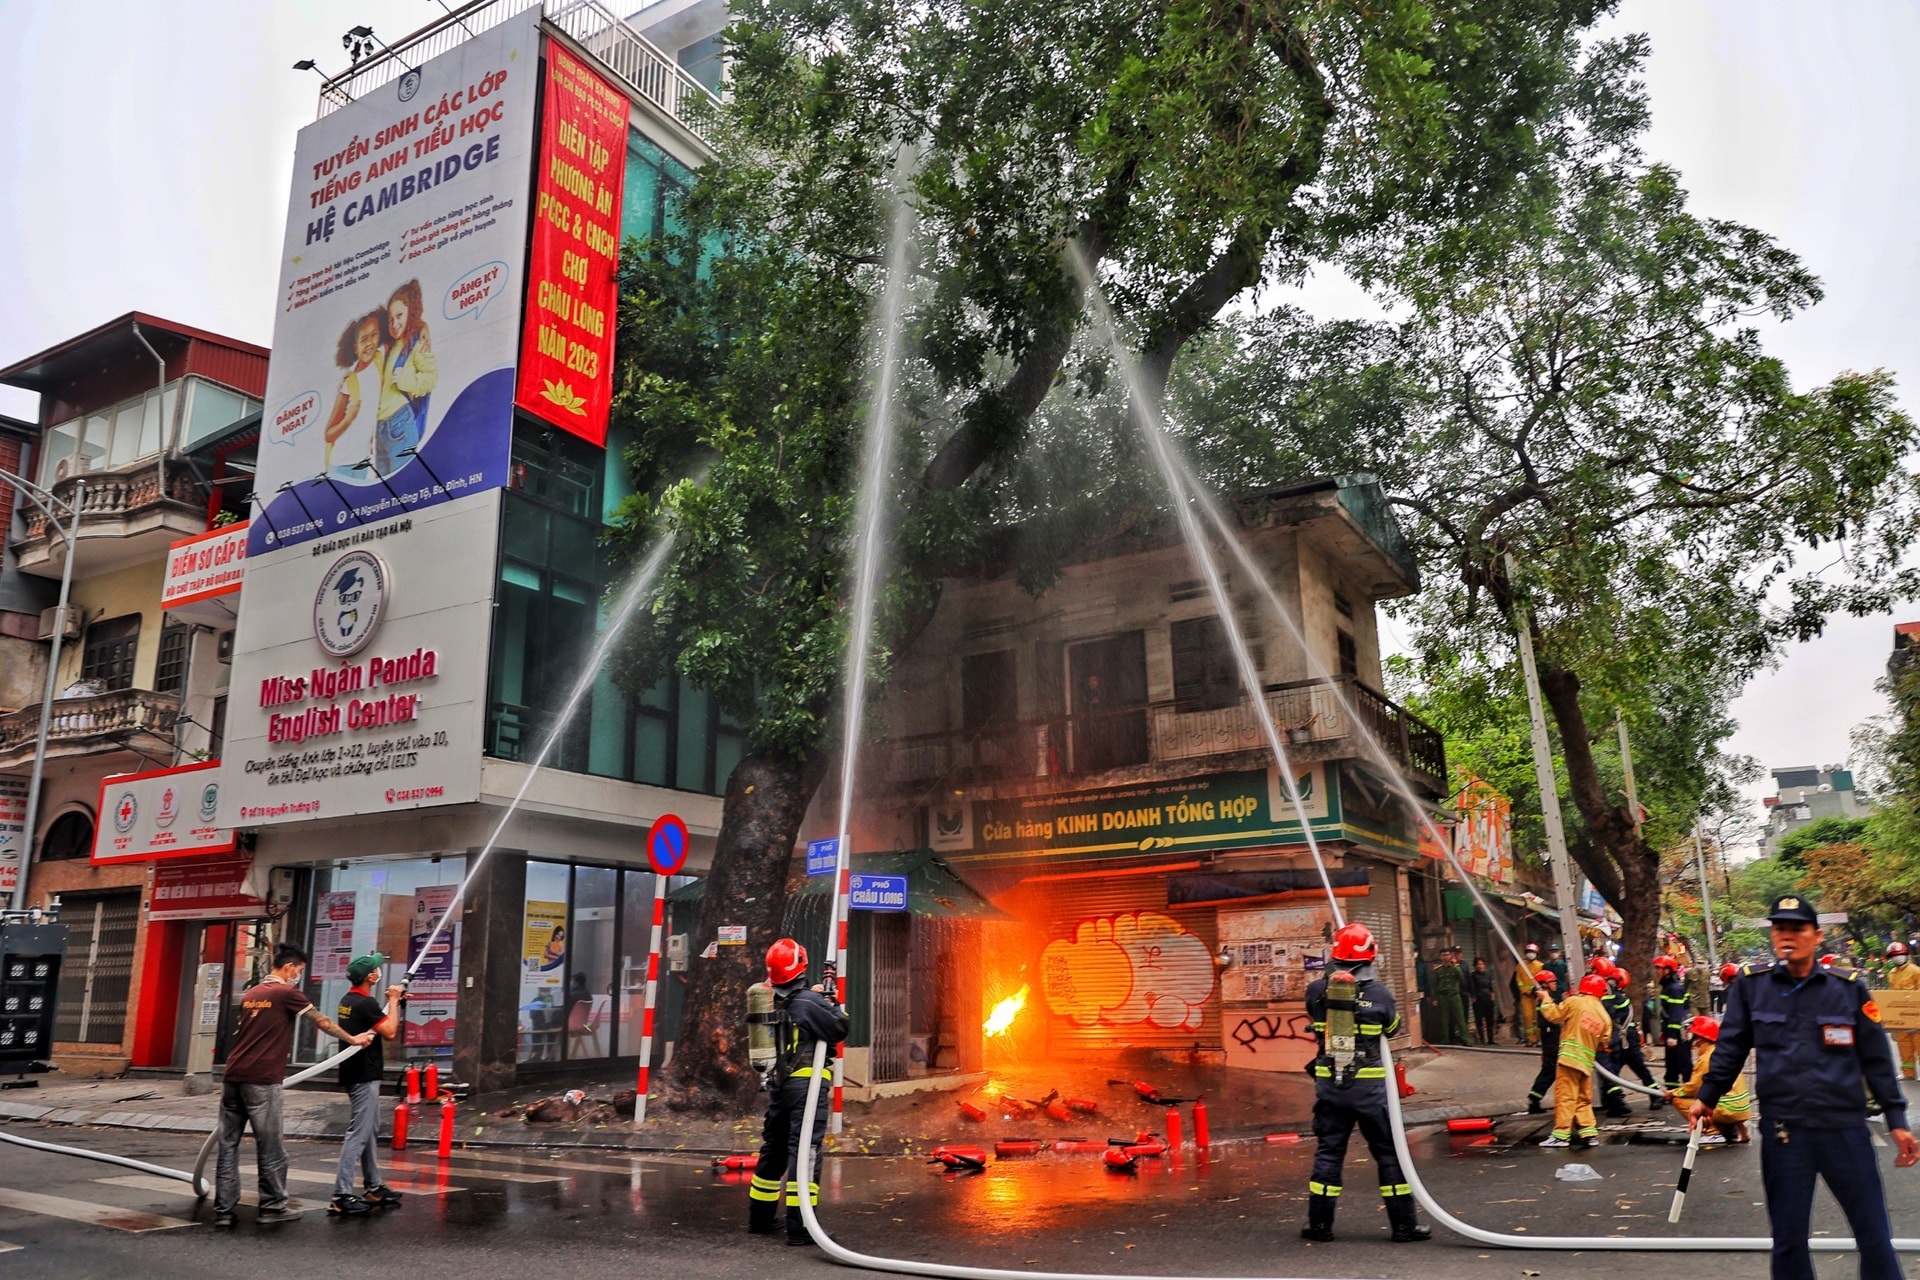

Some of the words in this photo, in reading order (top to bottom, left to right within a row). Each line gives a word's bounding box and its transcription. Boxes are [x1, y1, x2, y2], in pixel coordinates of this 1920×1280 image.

[313, 135, 370, 180] TUYỂN
[374, 113, 419, 150] SINH
[423, 94, 463, 126] CÁC
[468, 70, 508, 105] LỚP
[558, 118, 586, 160] DIỄN
[588, 139, 609, 175] TẬP
[310, 171, 361, 210] TIẾNG
[365, 151, 408, 182] ANH
[413, 120, 455, 158] TIỂU
[459, 101, 504, 138] HỌC
[306, 206, 336, 246] HỆ
[342, 134, 500, 227] CAMBRIDGE
[550, 153, 594, 206] PHƯƠNG
[596, 182, 612, 218] ÁN
[434, 216, 446, 225] cho
[464, 202, 478, 212] học
[480, 194, 494, 206] sinh
[538, 192, 570, 233] PCCC
[572, 214, 582, 241] &
[586, 220, 614, 261] CNCH
[356, 241, 390, 260] Cambridge
[562, 250, 588, 291] CHỢ
[451, 272, 482, 300] ĐĂNG
[484, 267, 499, 286] KÝ
[460, 286, 490, 309] NGAY
[538, 280, 571, 321] CHÂU
[572, 298, 604, 338] LONG
[538, 322, 566, 364] NĂM
[567, 341, 598, 380] 2023
[276, 406, 301, 426] ĐĂNG
[302, 396, 314, 412] KÝ
[282, 414, 307, 435] NGAY
[361, 498, 390, 516] Nguyễn
[468, 472, 482, 486] HN
[170, 546, 197, 578] ĐIỂM
[198, 546, 214, 570] SƠ
[215, 536, 235, 566] CẤP
[260, 675, 306, 707] Miss
[310, 660, 365, 700] Ngân
[368, 648, 436, 688] Panda
[268, 703, 341, 743] English
[347, 693, 420, 730] Center
[245, 757, 277, 774] Chuyên
[278, 752, 300, 768] tiếng
[301, 752, 318, 766] Anh
[320, 748, 336, 764] lớp
[366, 740, 392, 756] luyện
[394, 736, 408, 750] thi
[410, 734, 429, 748] vào
[267, 772, 280, 785] ôn
[281, 769, 293, 783] thi
[294, 767, 310, 784] Đại
[310, 763, 328, 779] học
[330, 763, 341, 777] và
[343, 757, 372, 776] chứng
[374, 755, 388, 771] chỉ
[389, 752, 417, 770] IELTS
[982, 821, 1012, 840] Cửa
[1016, 820, 1053, 840] hàng
[1057, 813, 1098, 835] KINH
[1102, 807, 1161, 831] DOANH
[1165, 795, 1215, 824] TỔNG
[1219, 795, 1258, 823] HỢP
[852, 889, 878, 903] CHÂU
[879, 892, 904, 904] LONG
[872, 880, 890, 888] PHỐ
